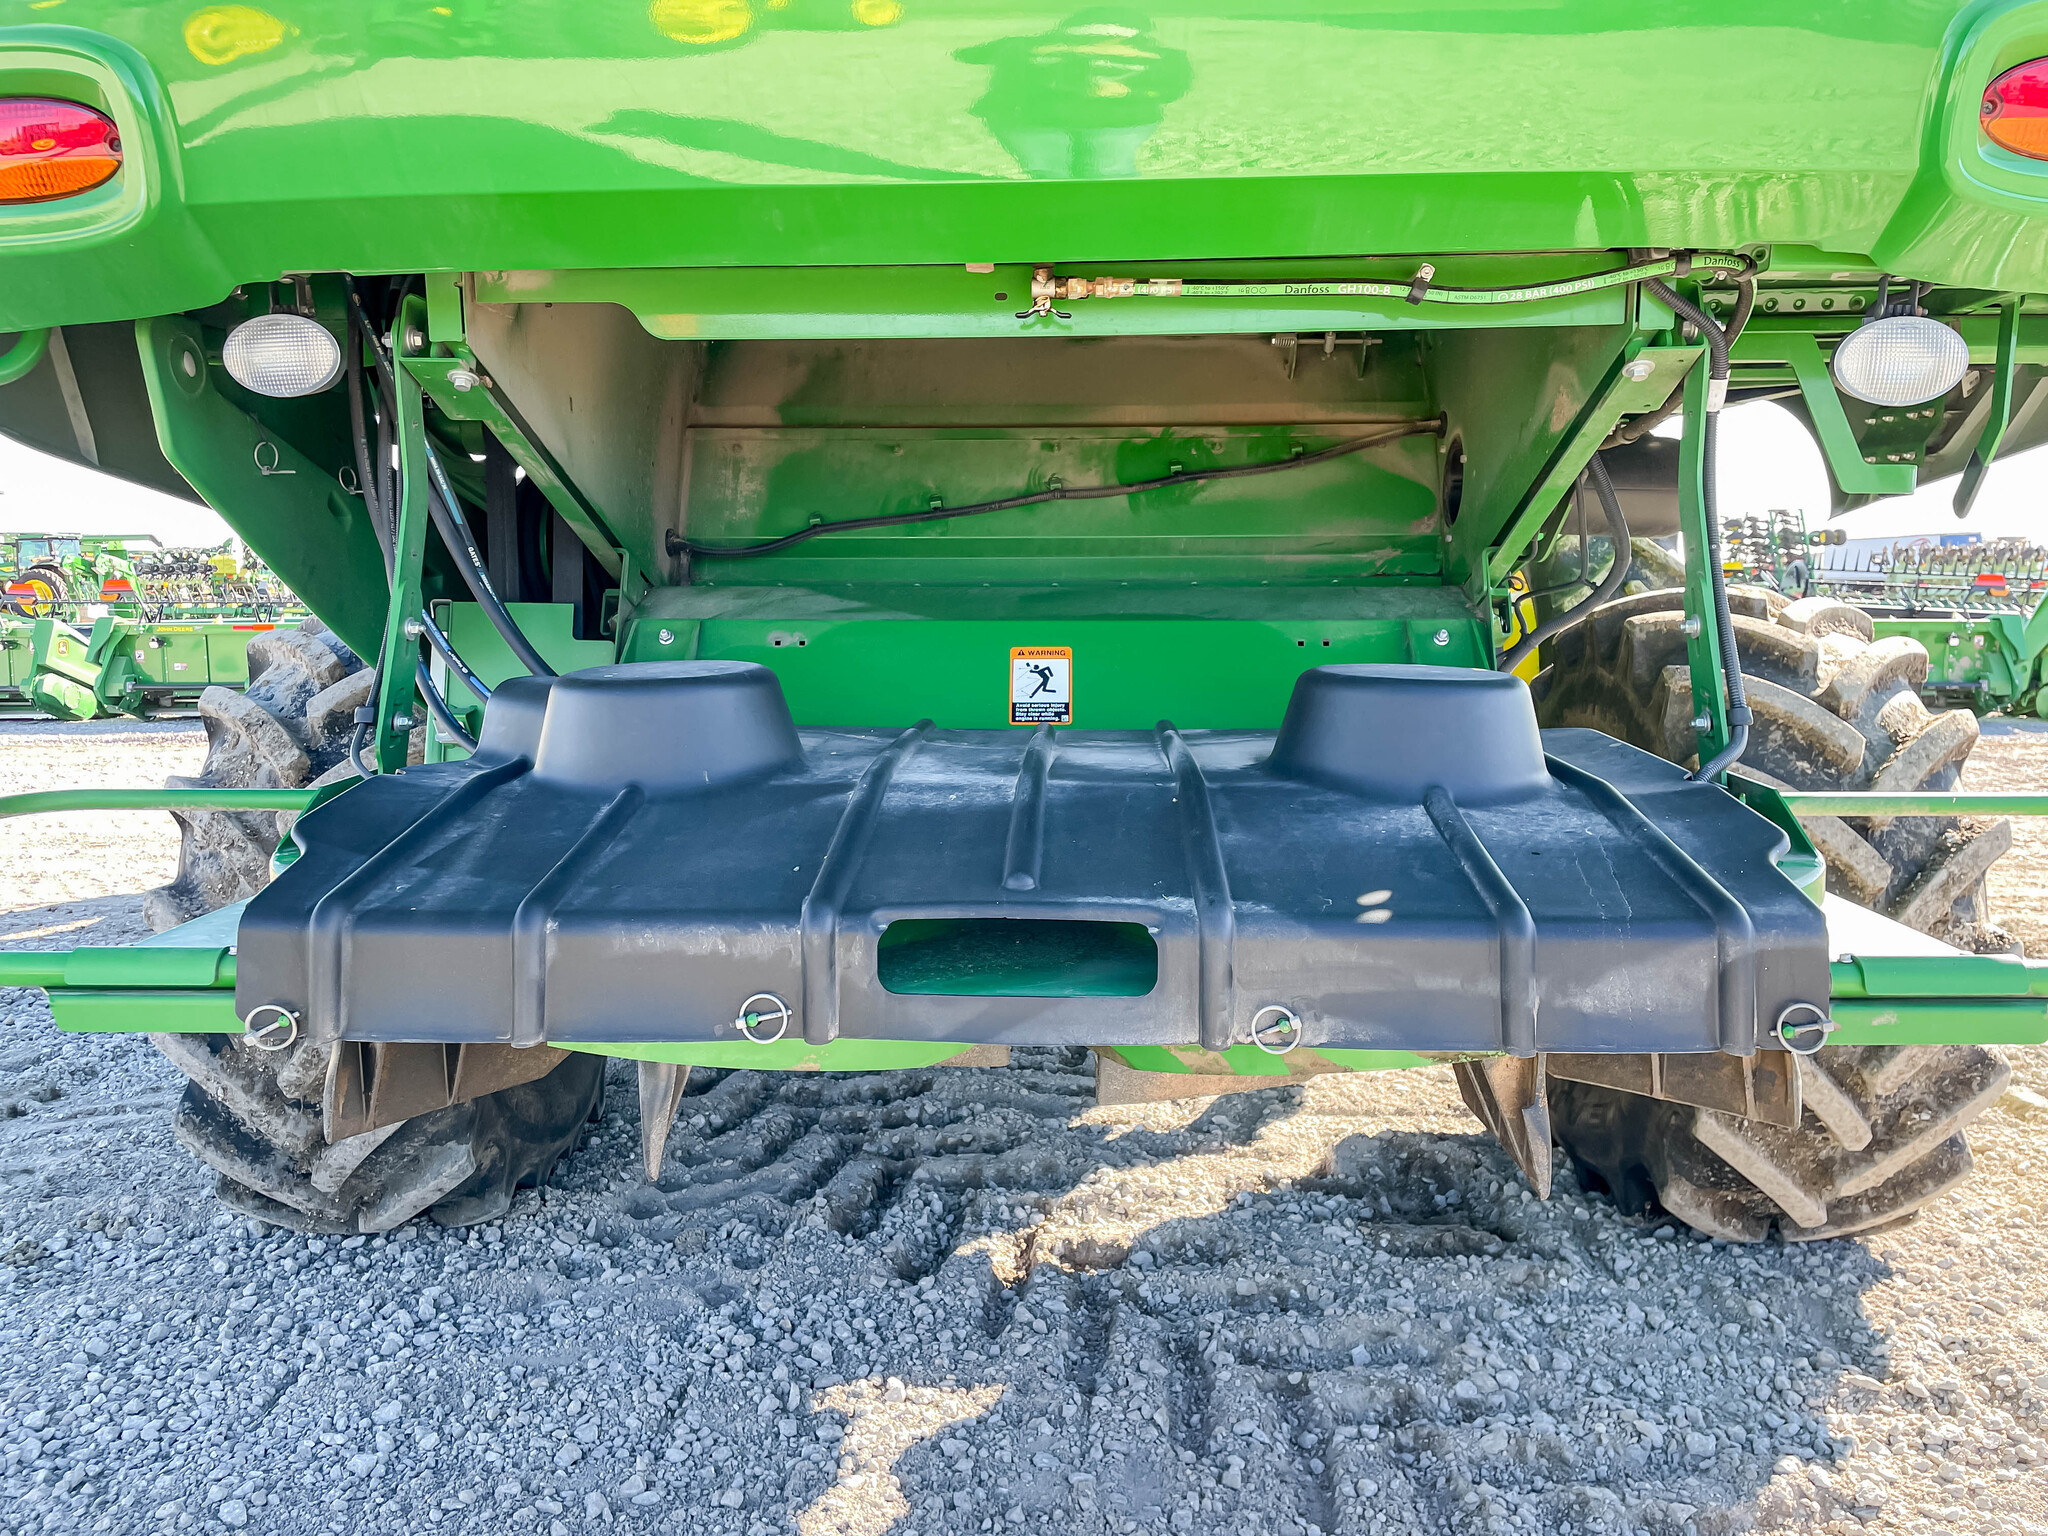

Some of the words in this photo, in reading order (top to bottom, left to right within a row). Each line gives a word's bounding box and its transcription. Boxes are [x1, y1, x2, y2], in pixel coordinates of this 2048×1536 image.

[1703, 256, 1740, 268] Danfoss
[1284, 284, 1330, 294] Danfoss
[1338, 284, 1391, 295] GH100-8
[1510, 292, 1523, 300] 28
[1525, 288, 1547, 299] BAR
[1549, 284, 1573, 295] (400
[1574, 279, 1595, 291] PSI)
